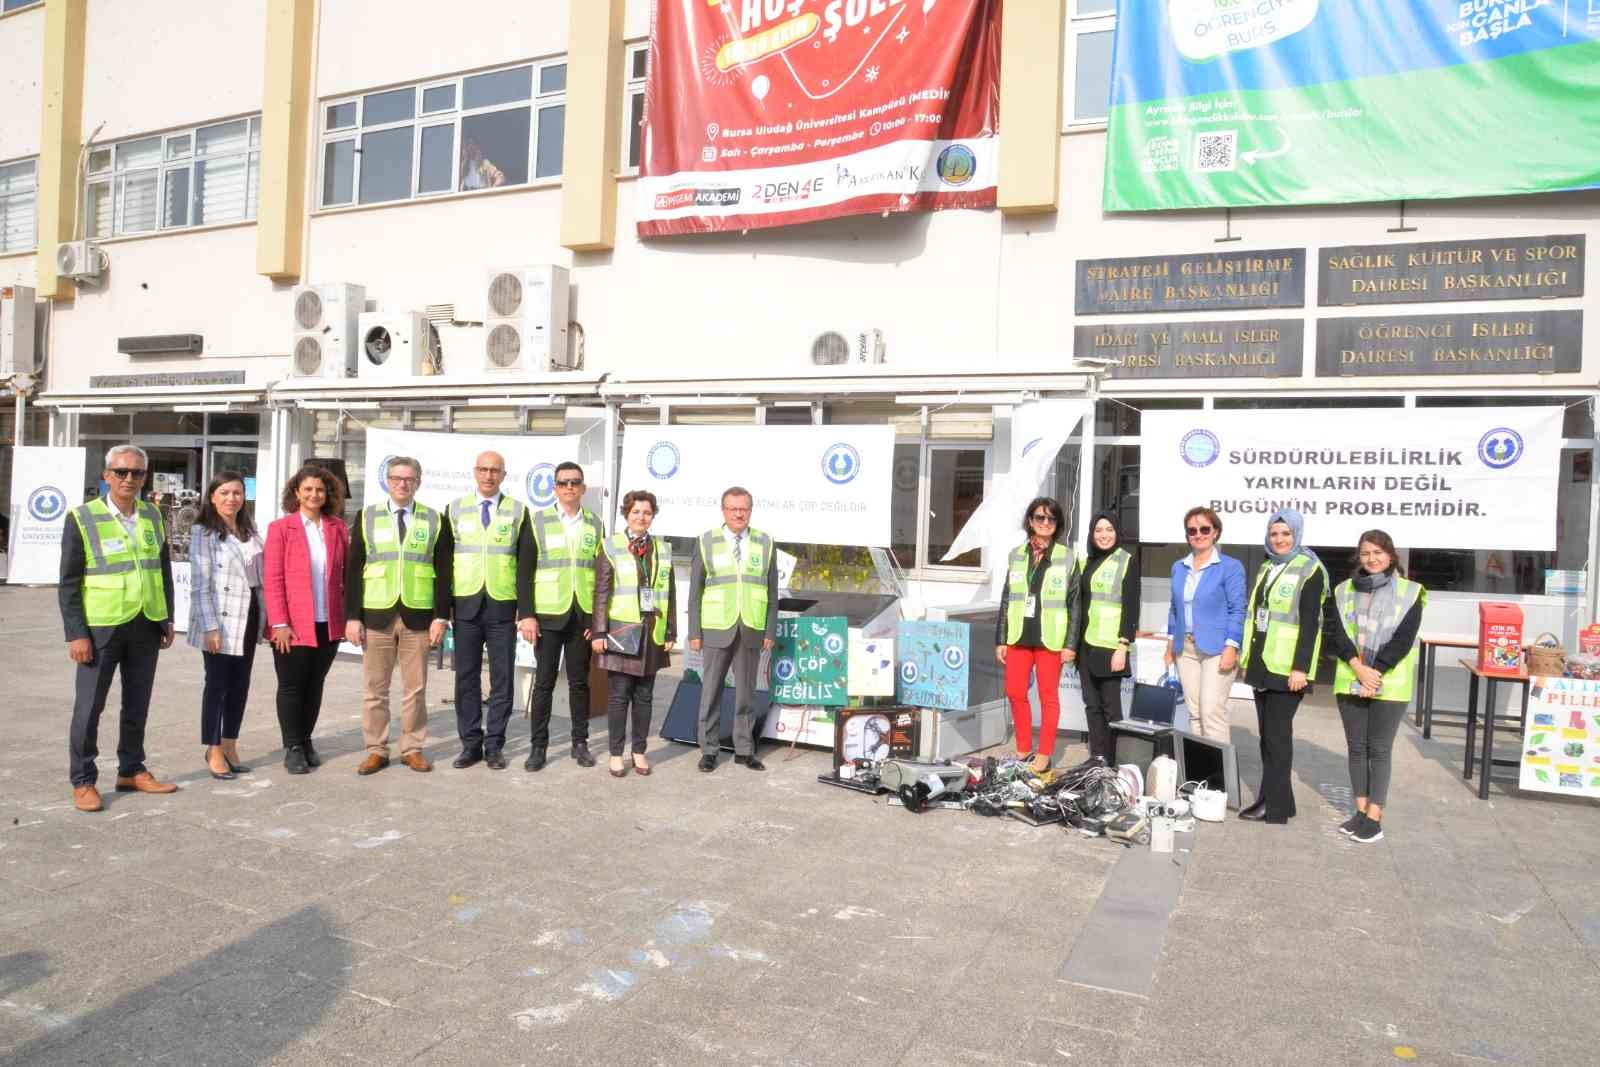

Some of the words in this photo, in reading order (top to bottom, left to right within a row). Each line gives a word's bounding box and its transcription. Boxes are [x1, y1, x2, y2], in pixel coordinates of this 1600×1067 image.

[1460, 12, 1532, 47] BAŞLA
[722, 128, 753, 138] Bursa
[695, 189, 740, 203] AKADEMİ
[1489, 247, 1518, 264] VE
[1525, 245, 1577, 261] SPOR
[1229, 447, 1463, 466] SÜRDÜRÜLEBİLİRLİK
[1384, 473, 1452, 492] DEĞİL
[1325, 498, 1488, 517] PROBLEMİDİR.
[799, 656, 828, 673] ÇÖP
